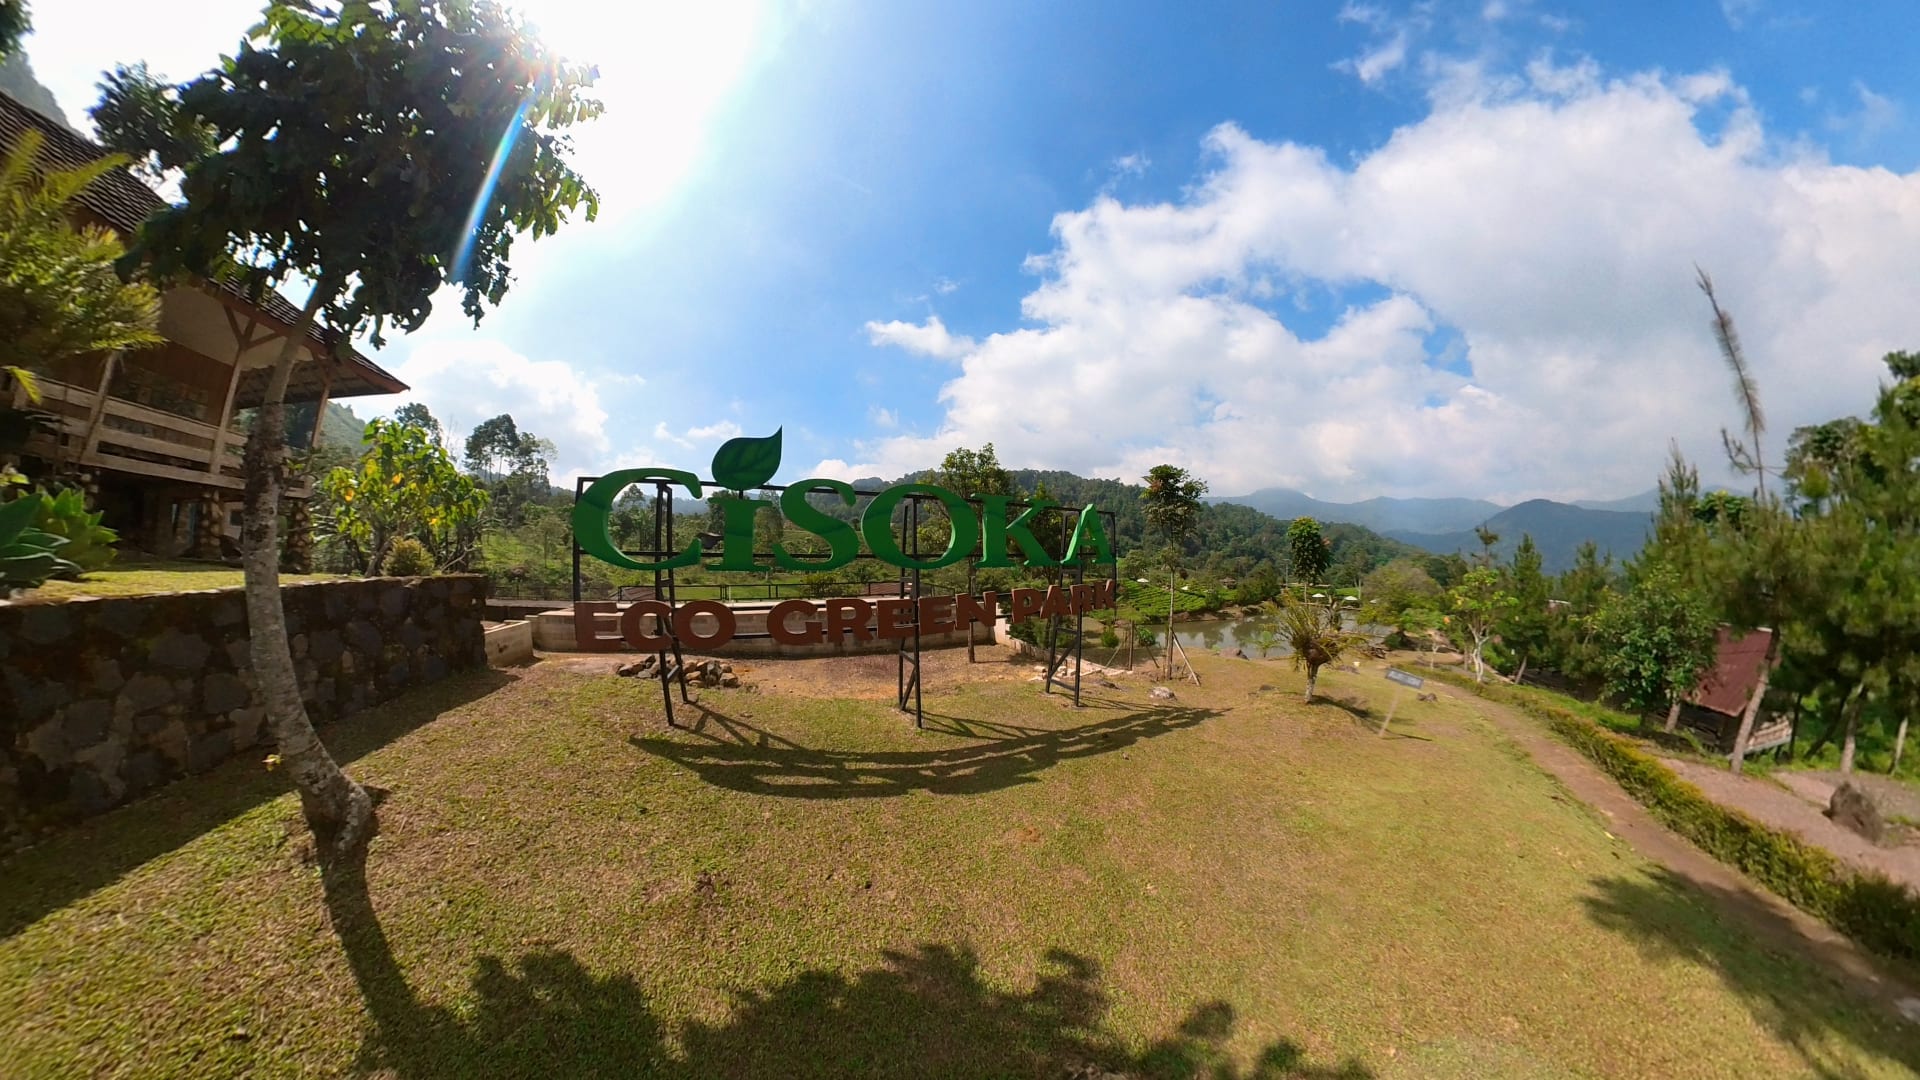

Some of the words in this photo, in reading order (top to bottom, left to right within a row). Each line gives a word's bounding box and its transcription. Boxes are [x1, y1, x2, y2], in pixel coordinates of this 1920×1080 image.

[574, 599, 736, 651] ECO
[766, 591, 997, 646] GREEN
[1011, 579, 1117, 624] PARK
